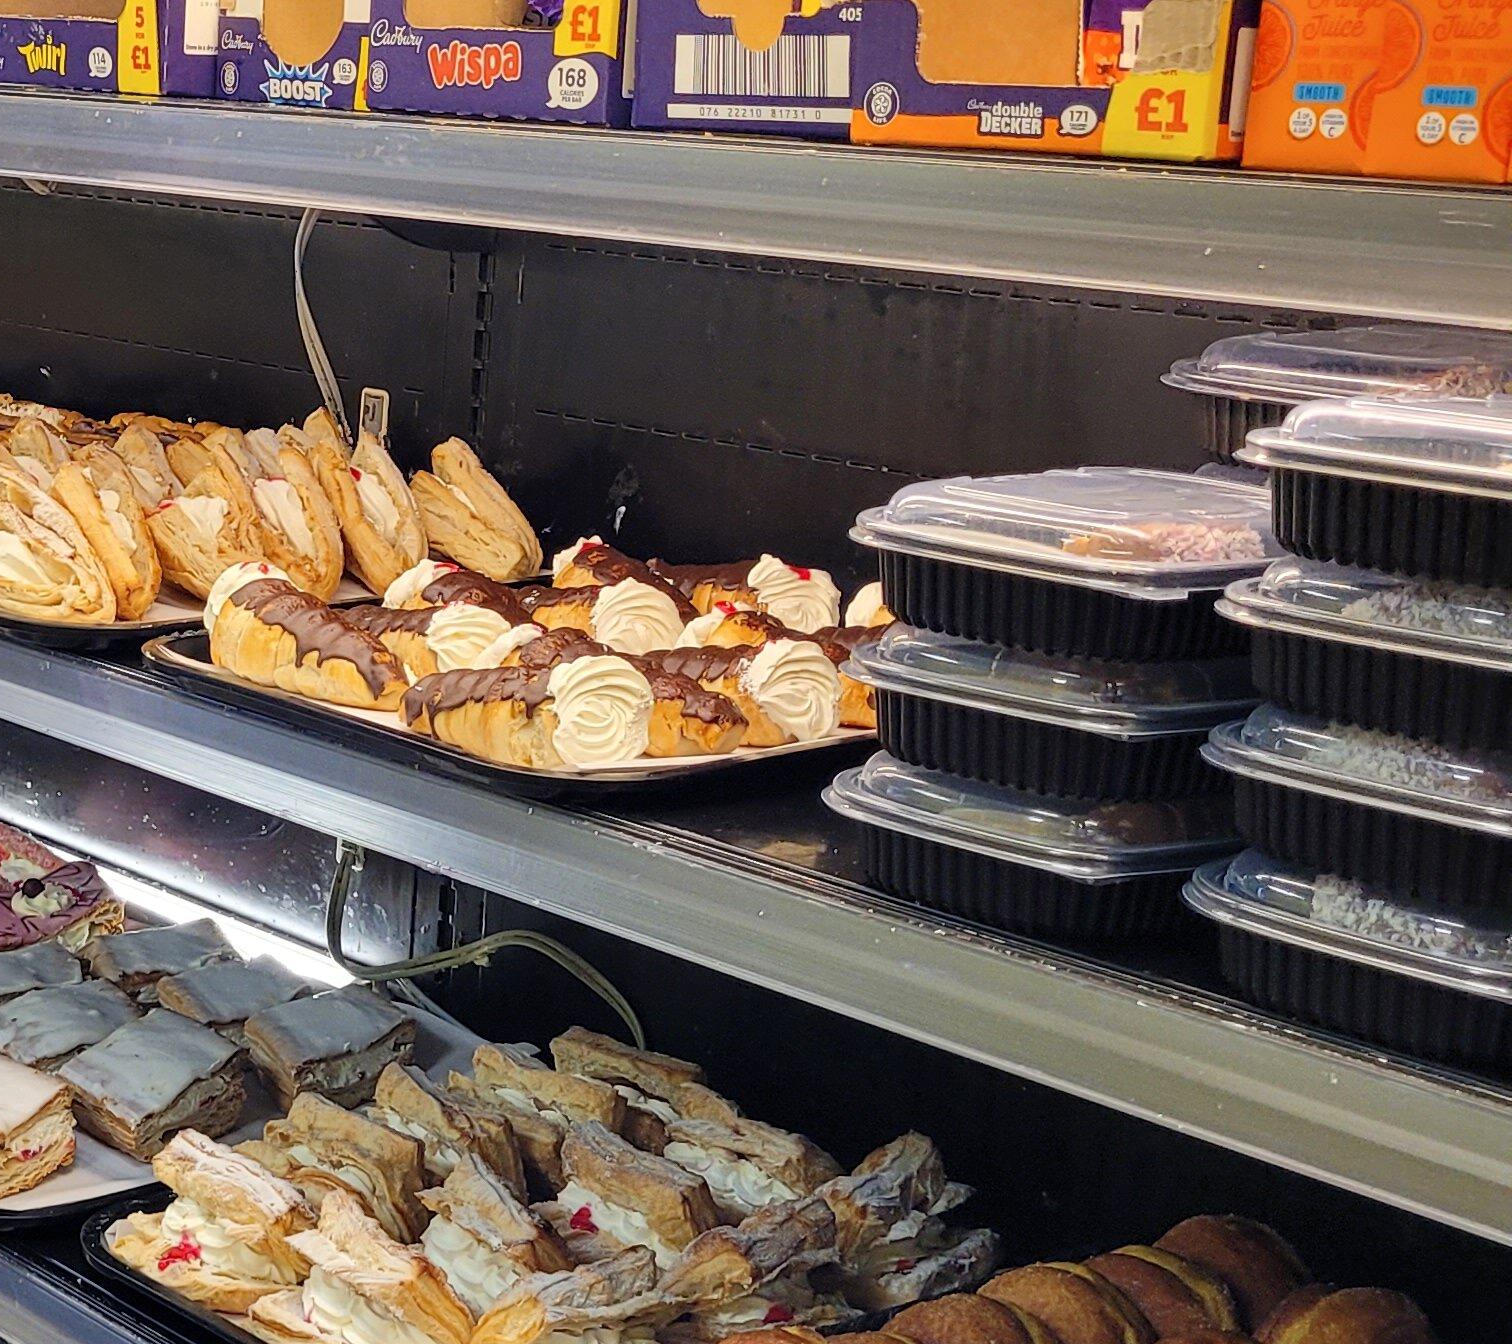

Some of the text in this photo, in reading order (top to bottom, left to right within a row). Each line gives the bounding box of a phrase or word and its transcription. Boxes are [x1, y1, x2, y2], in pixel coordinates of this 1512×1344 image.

[135, 7, 144, 27] 5
[570, 5, 600, 43] £1
[838, 7, 862, 22] 405
[370, 18, 423, 53] Cadbury
[1303, 14, 1365, 41] Juice
[1433, 14, 1501, 42] Juice
[221, 29, 254, 55] Cadbury
[17, 34, 68, 76] Twirl
[92, 51, 107, 65] 114
[131, 45, 152, 71] £1
[428, 41, 522, 89] Wispa
[338, 63, 352, 74] 163
[557, 68, 586, 88] 168
[269, 78, 324, 102] BOOST
[560, 90, 584, 98] CALORIES
[1299, 85, 1340, 100] SMOOTH
[1429, 88, 1472, 104] SMOOTH
[699, 107, 719, 117] 076
[727, 108, 762, 118] 22210
[771, 109, 806, 120] 81731
[992, 100, 1043, 117] double
[1069, 111, 1088, 122] 171
[1135, 87, 1188, 133] £1
[981, 116, 1042, 135] DECKER
